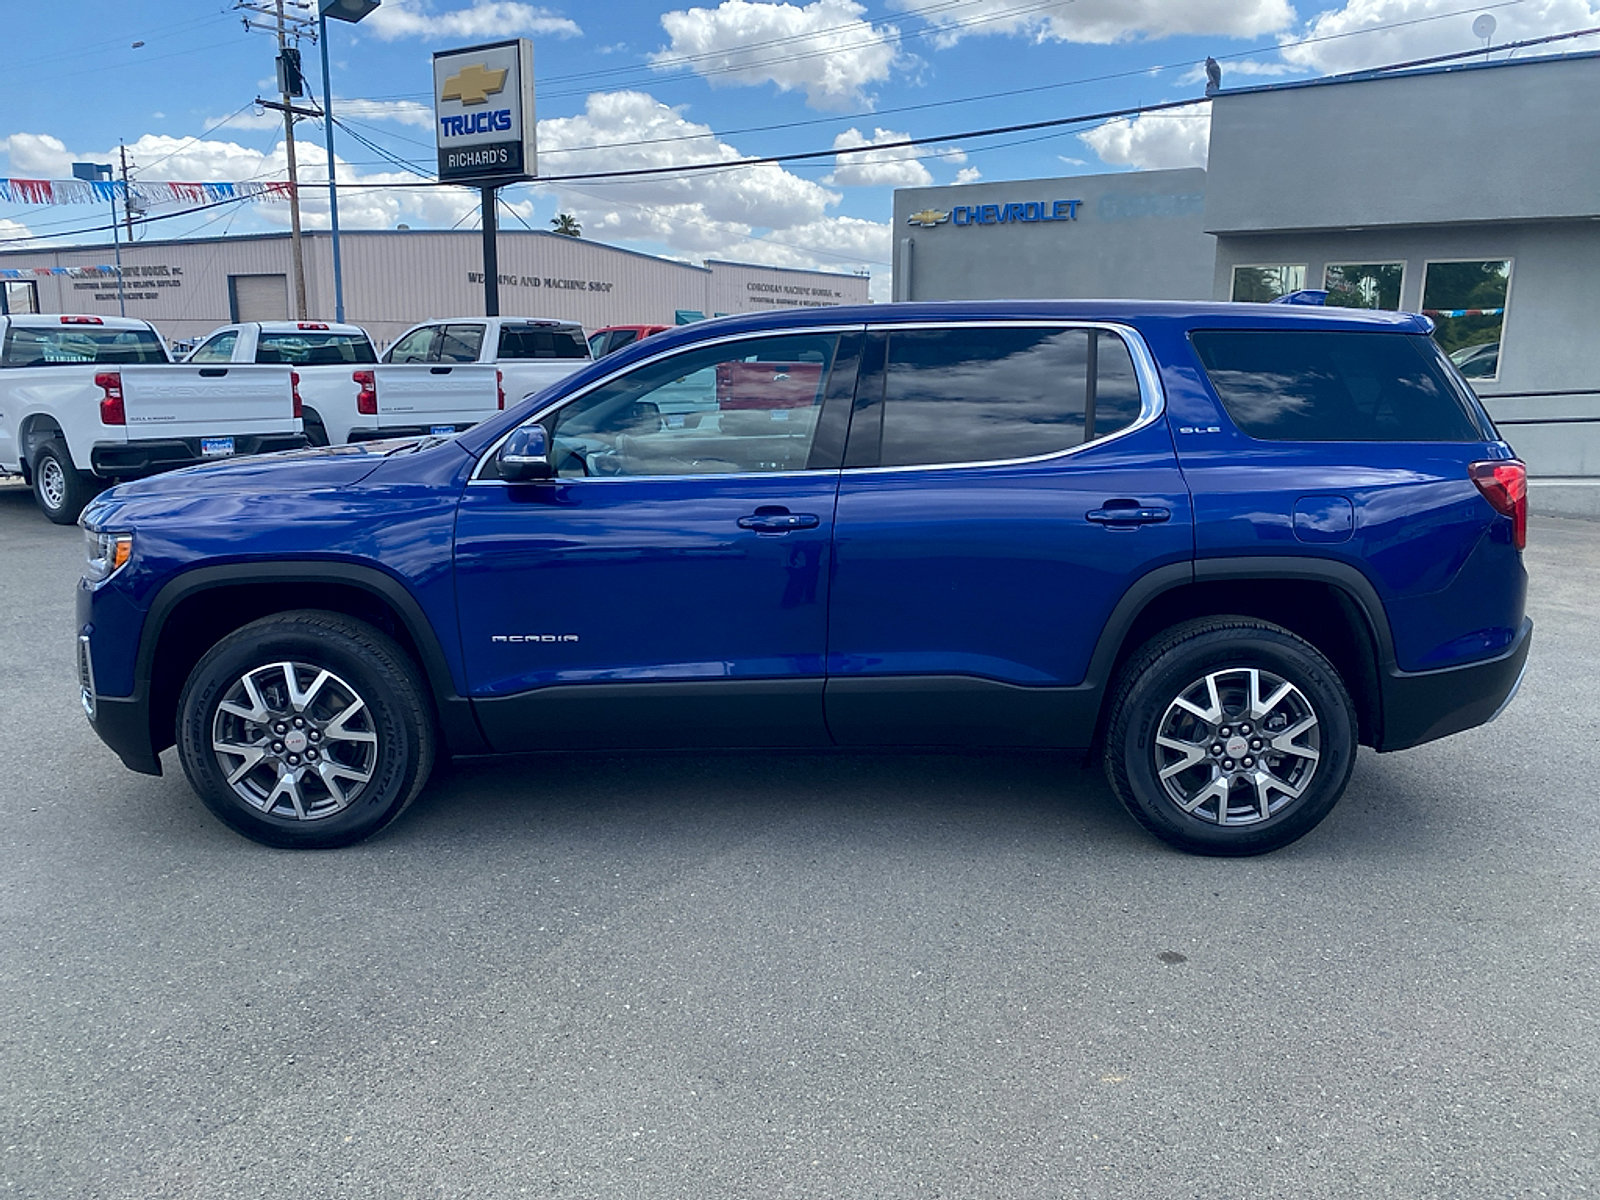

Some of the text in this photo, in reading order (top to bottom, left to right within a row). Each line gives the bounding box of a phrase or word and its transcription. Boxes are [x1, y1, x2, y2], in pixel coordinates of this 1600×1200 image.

[440, 109, 512, 137] TRUCKS
[448, 148, 508, 168] RICHARD'S
[952, 199, 1083, 226] CHEVROLET
[467, 272, 517, 286] WEING
[520, 275, 542, 288] AND
[544, 278, 587, 291] MACHINE
[1180, 426, 1221, 434] SLE
